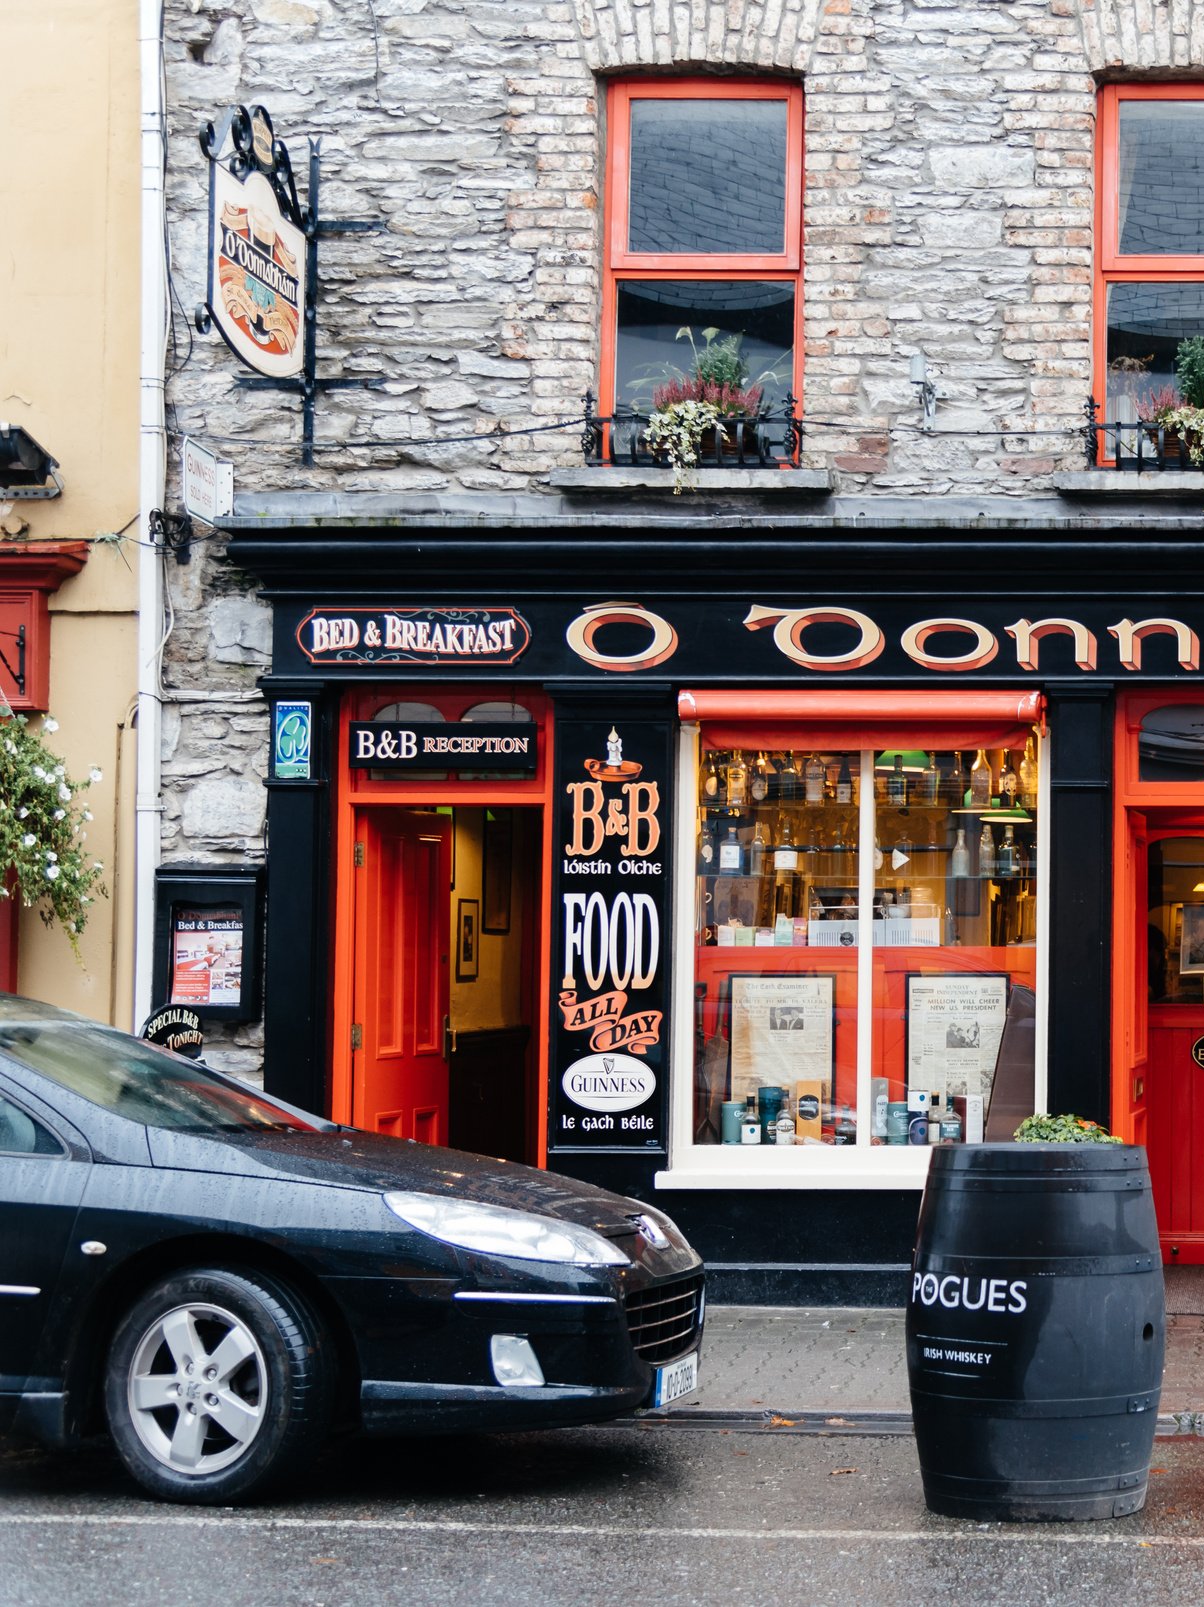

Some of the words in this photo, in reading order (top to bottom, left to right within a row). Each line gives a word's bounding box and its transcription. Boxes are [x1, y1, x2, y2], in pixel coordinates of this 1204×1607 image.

[311, 617, 360, 654] BED
[364, 624, 382, 649] &
[384, 614, 517, 656] BREAKFAST
[356, 730, 417, 759] B&B
[423, 737, 529, 753] RECEPTION
[565, 781, 660, 856] B&B
[178, 921, 195, 930] Bed
[197, 921, 205, 930] &
[207, 921, 243, 930] Breakfas
[564, 891, 659, 990] FOOD
[148, 1009, 182, 1038] SPECIAL
[182, 1009, 199, 1030] B&B
[570, 997, 619, 1026] ALL
[167, 1030, 203, 1051] TONIGHT
[608, 1014, 658, 1045] DAY
[571, 1074, 645, 1093] GUINNESS
[912, 1271, 1028, 1314] POGUES
[923, 1347, 943, 1359] IRISH
[945, 1349, 992, 1364] WHISKEY
